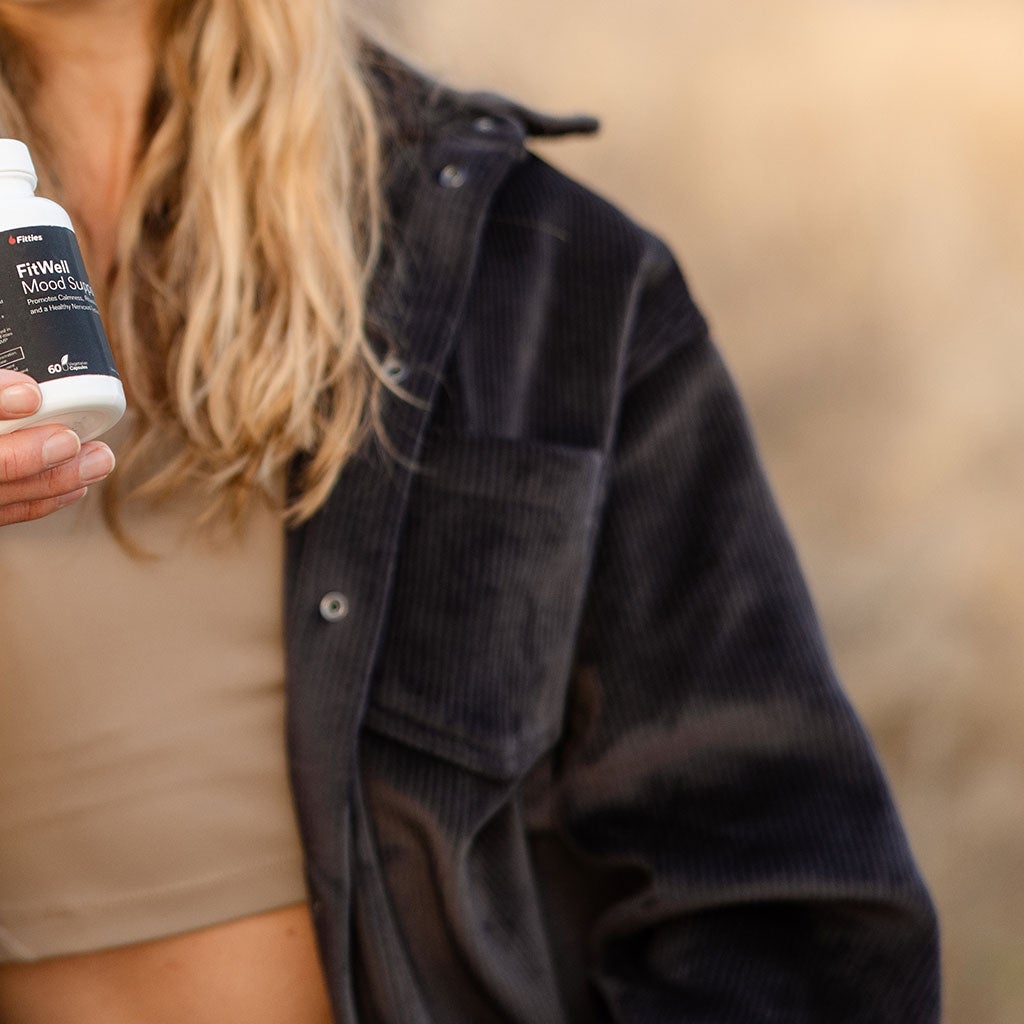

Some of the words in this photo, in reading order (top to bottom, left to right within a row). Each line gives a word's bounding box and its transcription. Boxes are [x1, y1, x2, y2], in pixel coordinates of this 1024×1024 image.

[16, 235, 43, 244] Fitties
[16, 260, 71, 279] FitWell
[21, 276, 66, 295] Mood
[27, 294, 58, 305] Promotes
[30, 306, 43, 315] and
[47, 363, 63, 374] 60
